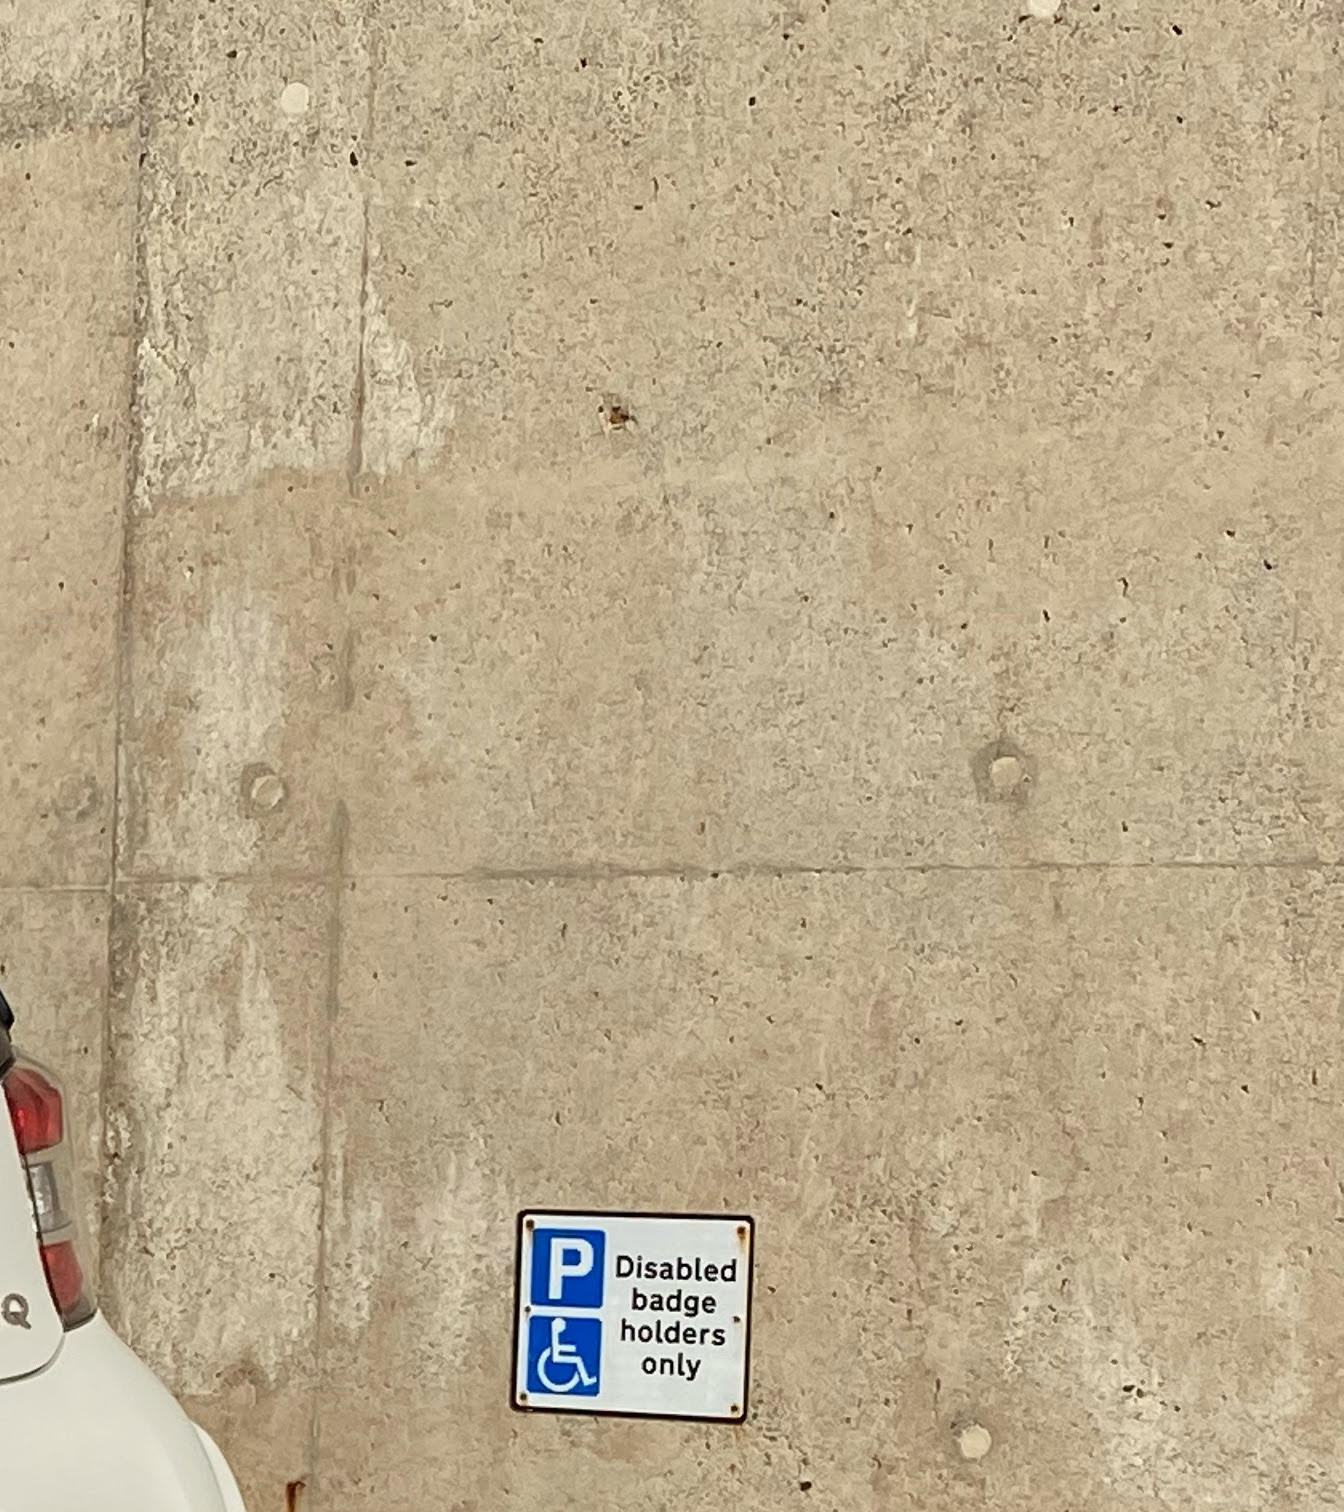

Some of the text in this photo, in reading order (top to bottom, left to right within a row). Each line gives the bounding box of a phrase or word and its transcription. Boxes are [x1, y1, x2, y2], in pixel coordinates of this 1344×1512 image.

[548, 1237, 594, 1299] P
[615, 1255, 737, 1282] Disabled
[631, 1287, 717, 1317] badge
[620, 1318, 725, 1346] holders
[641, 1352, 701, 1381] only
